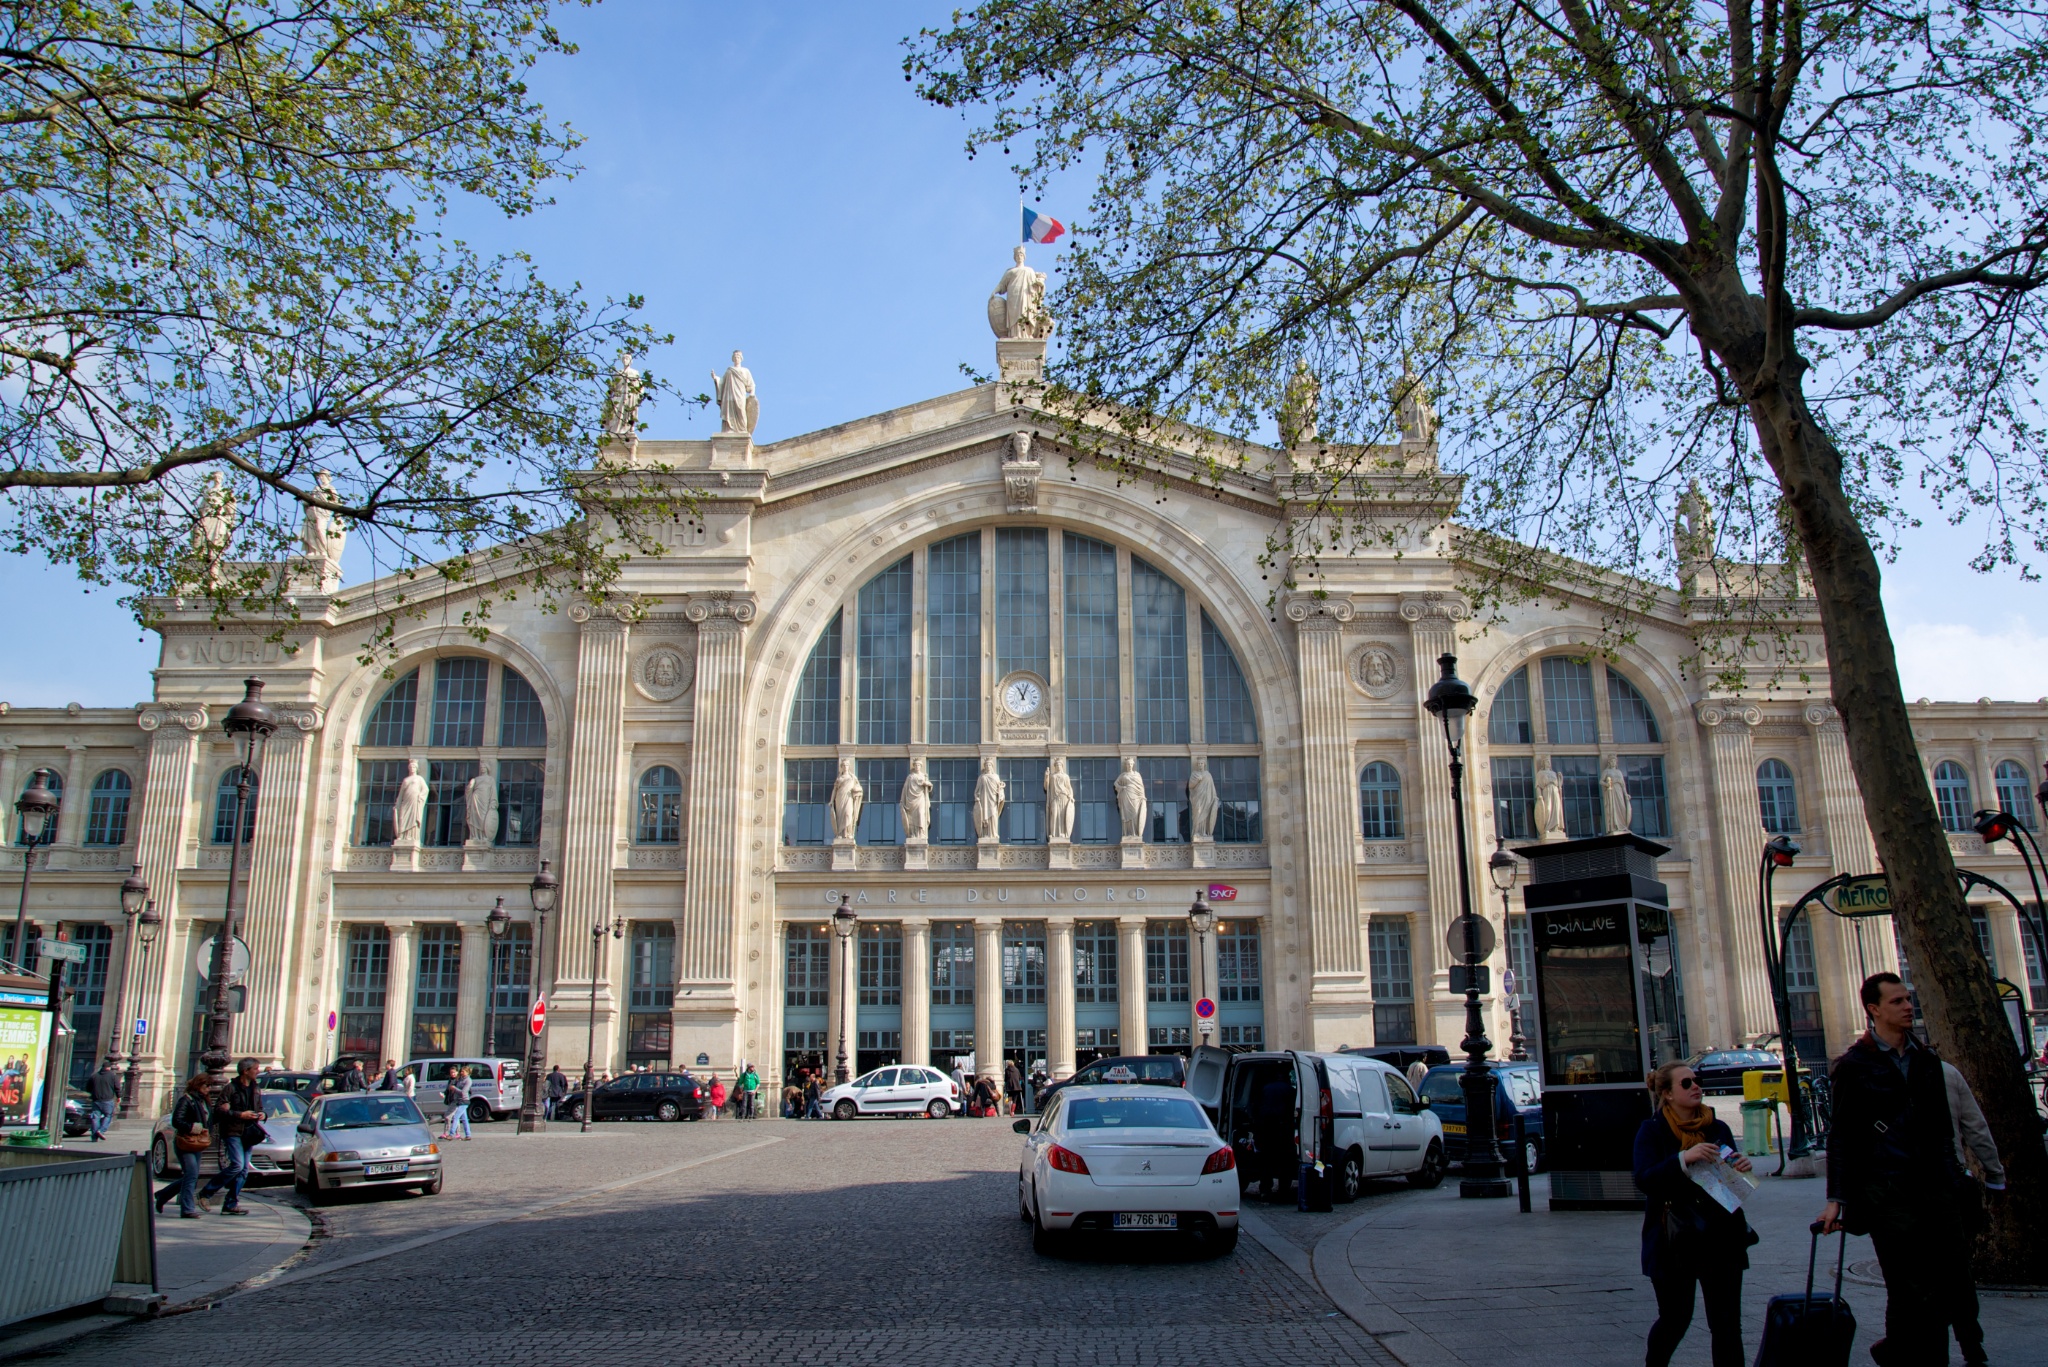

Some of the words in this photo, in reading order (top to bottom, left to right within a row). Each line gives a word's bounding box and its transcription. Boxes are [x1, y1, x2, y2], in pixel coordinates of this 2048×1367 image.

[193, 640, 281, 664] NORD
[825, 888, 927, 903] GARE
[967, 888, 1010, 902] DU
[1043, 887, 1148, 901] NORD
[1210, 889, 1237, 899] SNCF
[1547, 917, 1616, 935] OXIALIVE
